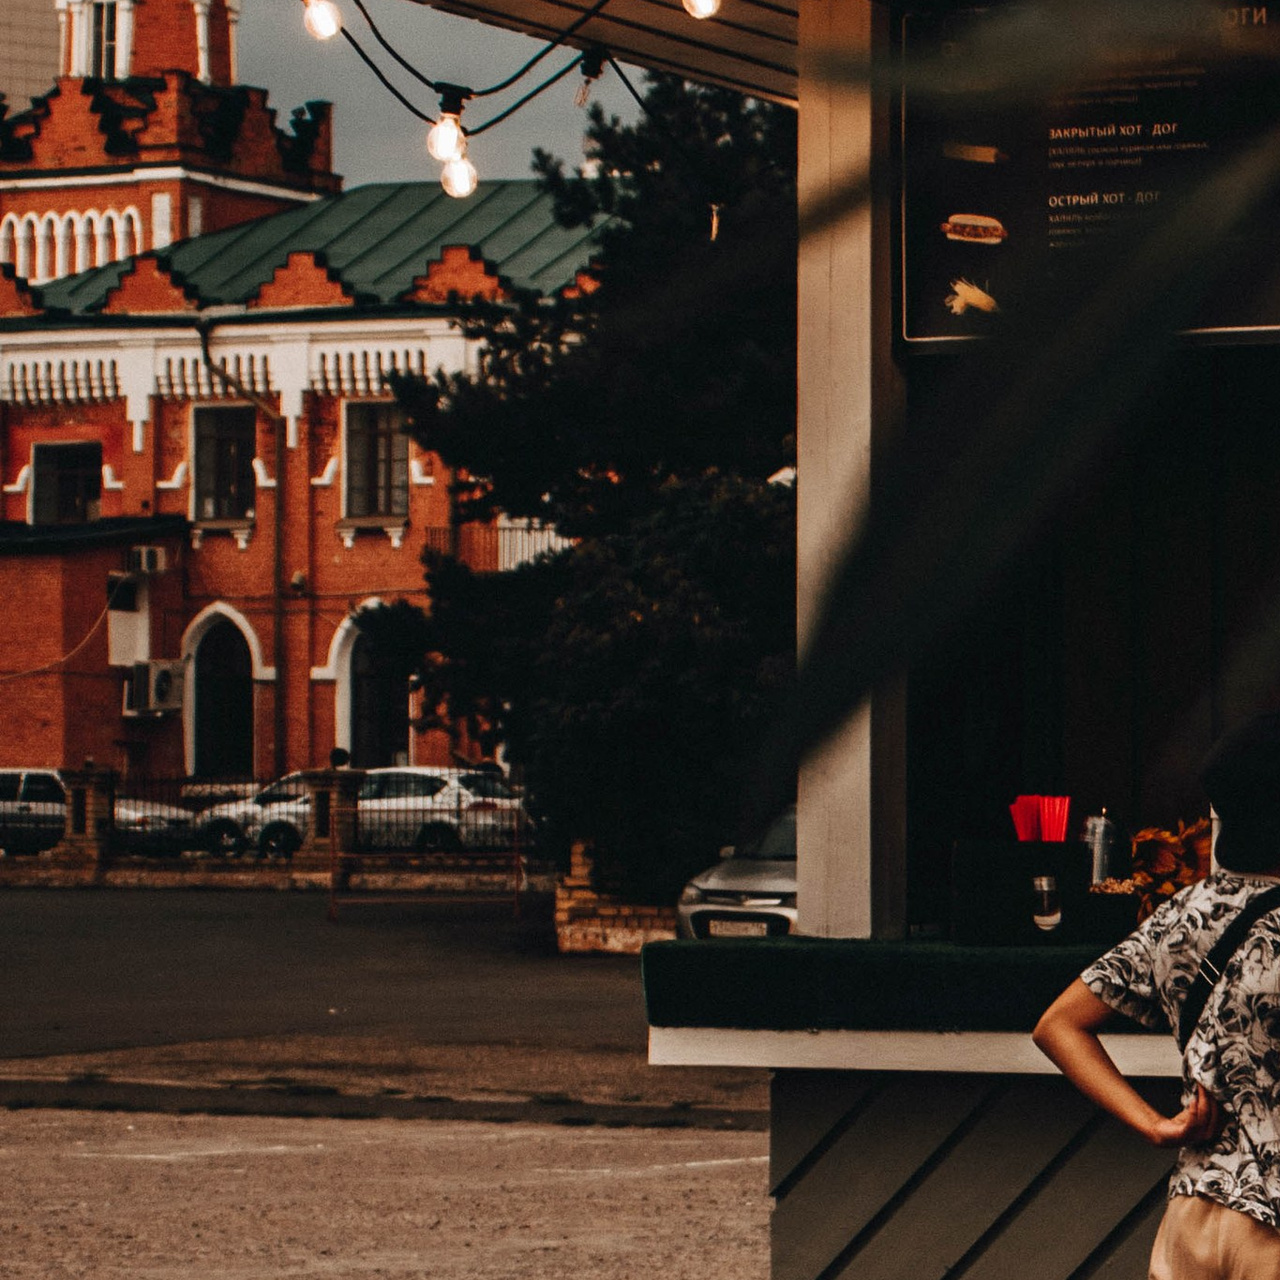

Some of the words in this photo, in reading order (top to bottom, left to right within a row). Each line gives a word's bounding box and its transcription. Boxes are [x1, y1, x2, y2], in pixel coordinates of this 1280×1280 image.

[1048, 123, 1117, 140] ЗАКРЫТЫЙ
[1119, 124, 1142, 137] ХОТ
[1152, 122, 1179, 137] ДОГ
[1048, 192, 1099, 208] ОСТРЫЙ
[1102, 192, 1126, 205] ХОТ
[1135, 191, 1161, 205] ДОГ
